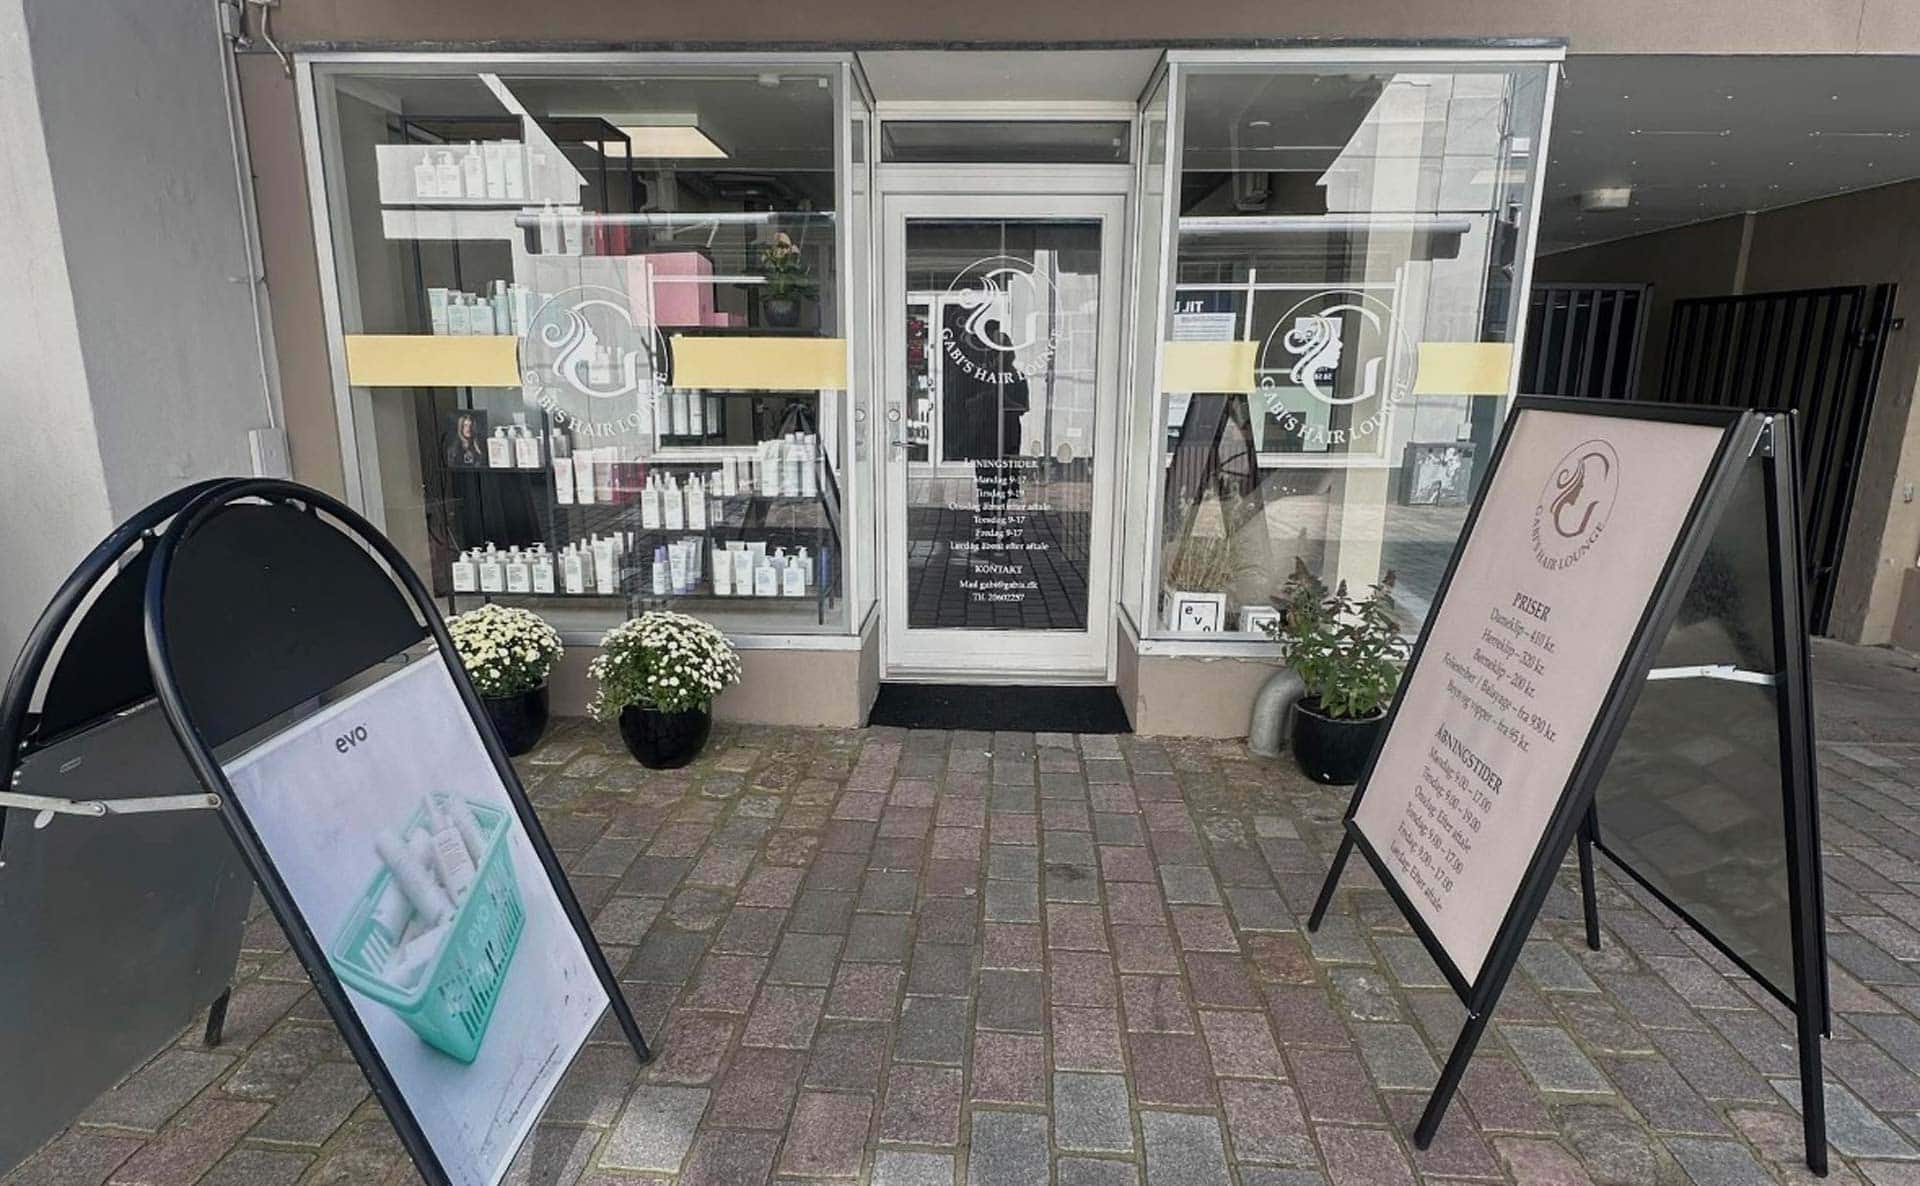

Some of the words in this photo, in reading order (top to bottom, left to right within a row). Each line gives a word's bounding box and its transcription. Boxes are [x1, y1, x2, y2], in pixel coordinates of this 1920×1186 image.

[942, 328, 974, 374] GABI'S
[974, 366, 1014, 384] HAIR
[1261, 376, 1298, 431] GABI'S
[1297, 424, 1346, 444] HAIR
[568, 417, 616, 436] HAIR
[1026, 541, 1049, 550] aftale
[1558, 522, 1604, 570] LOUNGE
[975, 565, 1022, 574] KONTAKT
[1512, 592, 1551, 622] PRISER
[336, 726, 368, 753] evo
[1436, 722, 1502, 794] ÅBNINGSTIDER
